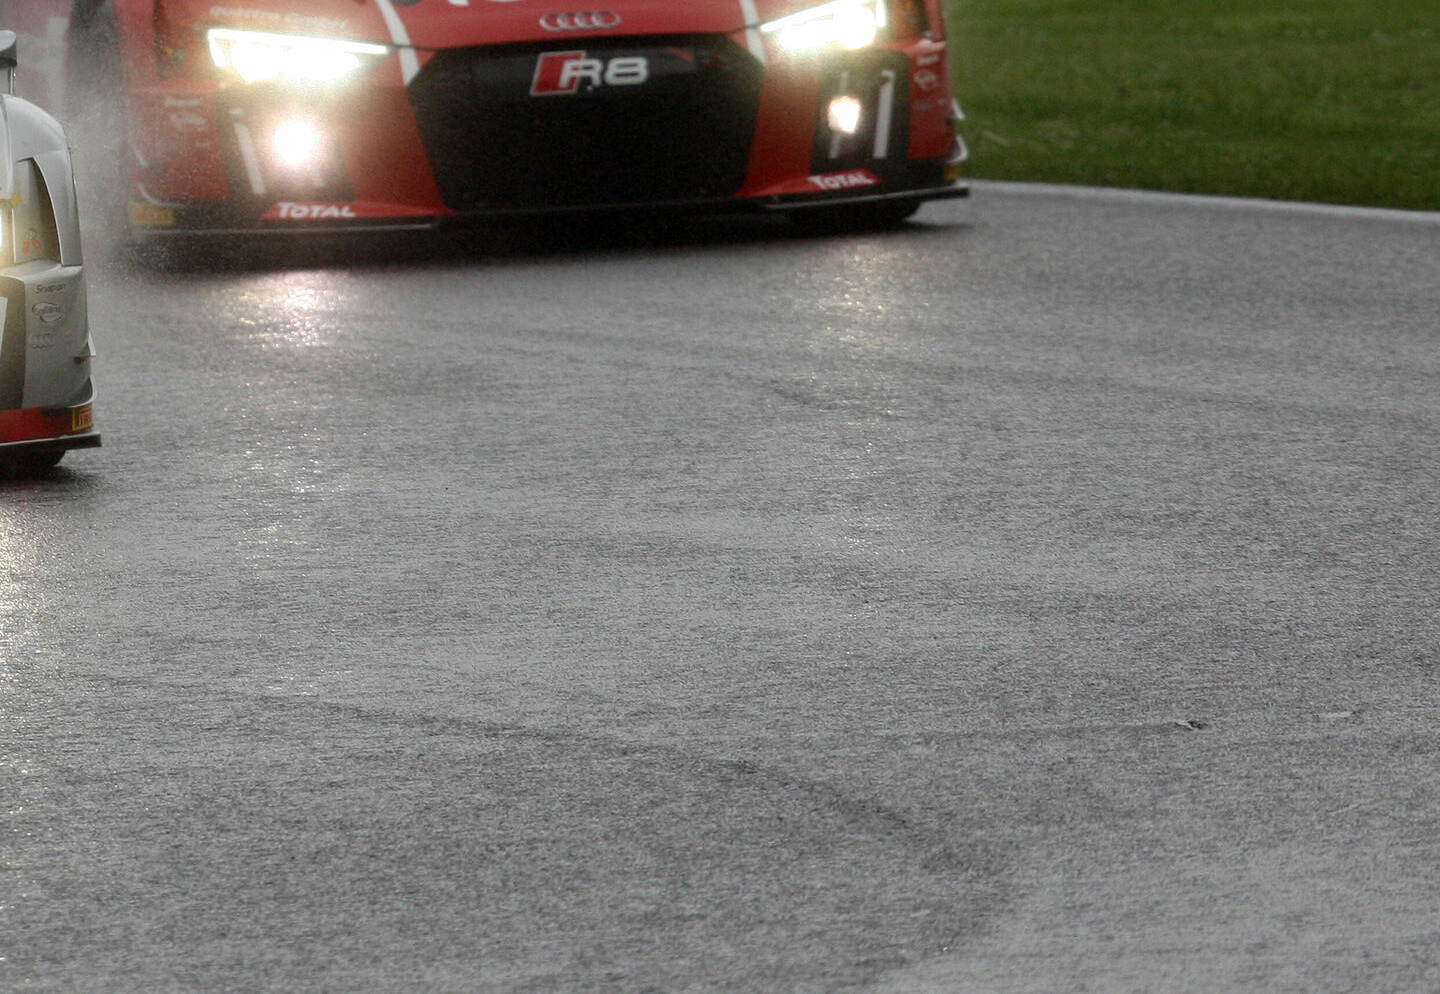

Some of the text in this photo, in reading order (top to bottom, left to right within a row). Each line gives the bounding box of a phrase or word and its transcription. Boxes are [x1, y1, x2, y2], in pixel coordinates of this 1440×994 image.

[559, 55, 649, 88] R8
[807, 170, 877, 190] TOTAL
[275, 201, 356, 218] TOTAL
